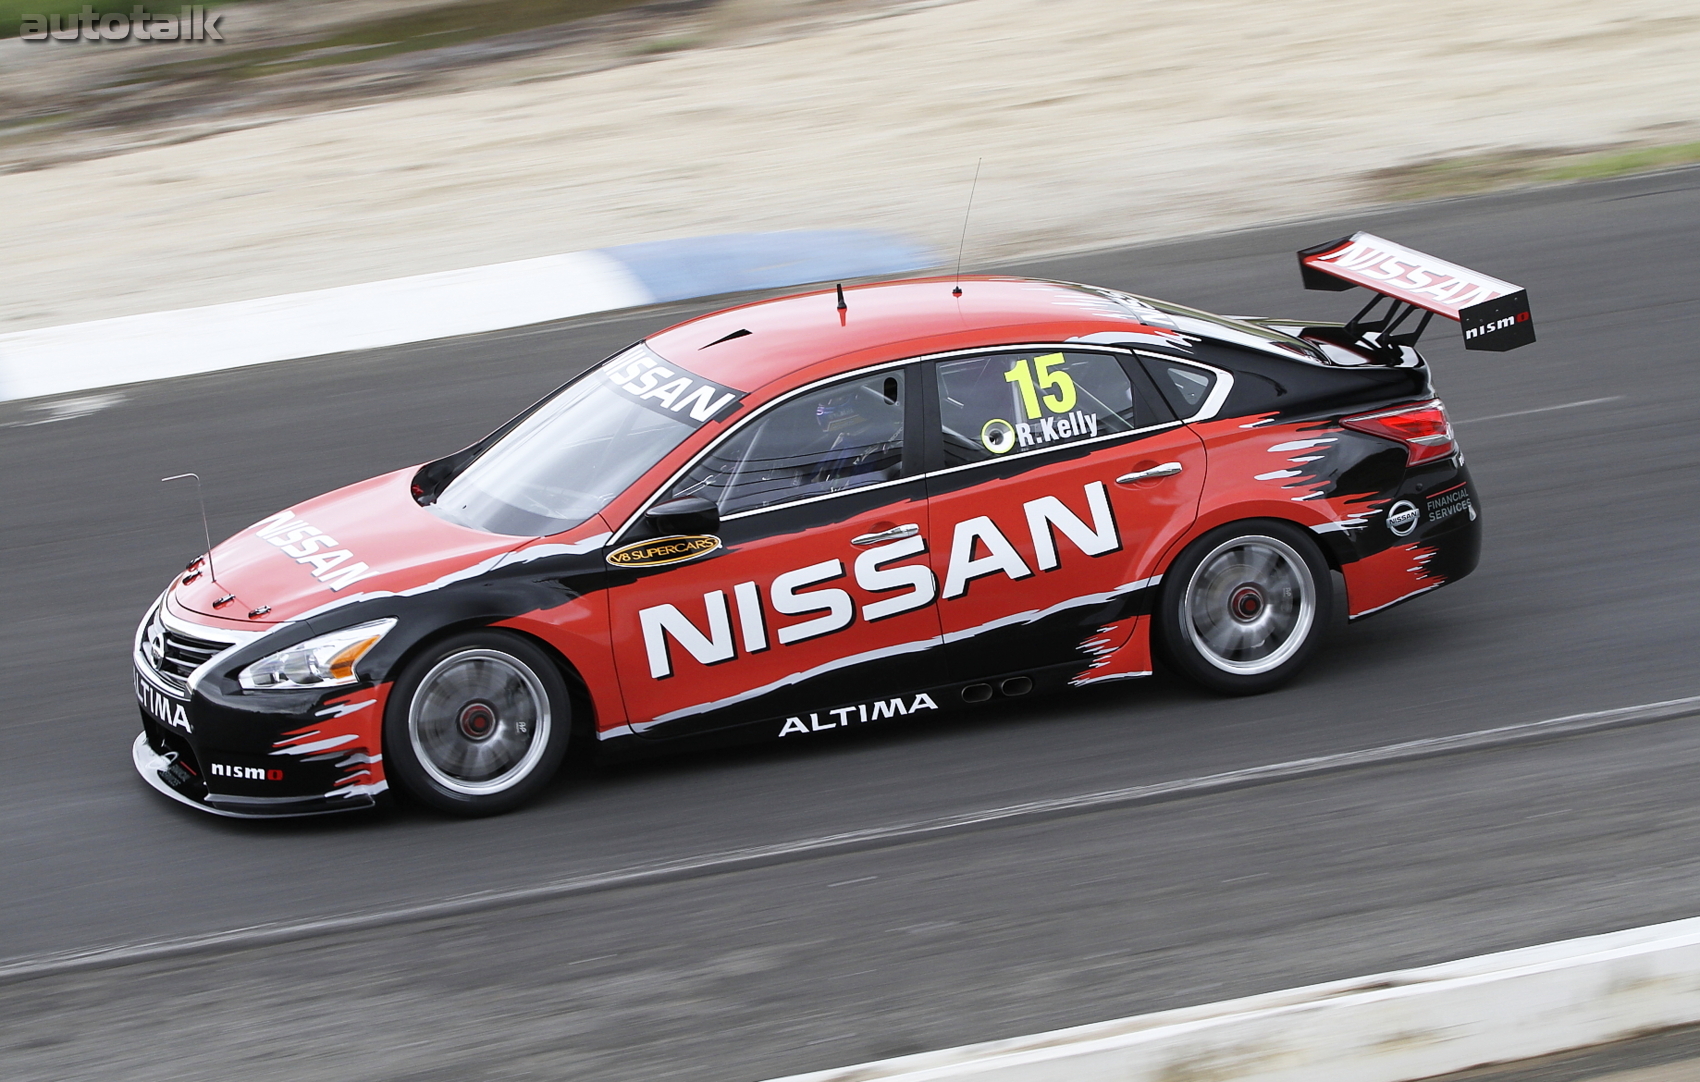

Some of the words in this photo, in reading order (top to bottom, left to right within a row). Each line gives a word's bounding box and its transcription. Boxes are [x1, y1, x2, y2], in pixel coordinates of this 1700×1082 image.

[1317, 244, 1502, 311] NISSAN
[1466, 311, 1530, 340] nismo
[1004, 352, 1077, 420] 15
[1015, 410, 1098, 448] R.Kelly
[1426, 487, 1469, 511] FINANCIAL
[1429, 498, 1471, 521] SERVICES
[1388, 510, 1418, 526] NISSAN
[248, 510, 380, 592] NISSAN
[611, 550, 632, 563] V8
[631, 539, 715, 561] SUPERCARS
[638, 480, 1121, 680] NISSAN
[778, 693, 939, 738] ALTIMA
[211, 762, 284, 782] nismo
